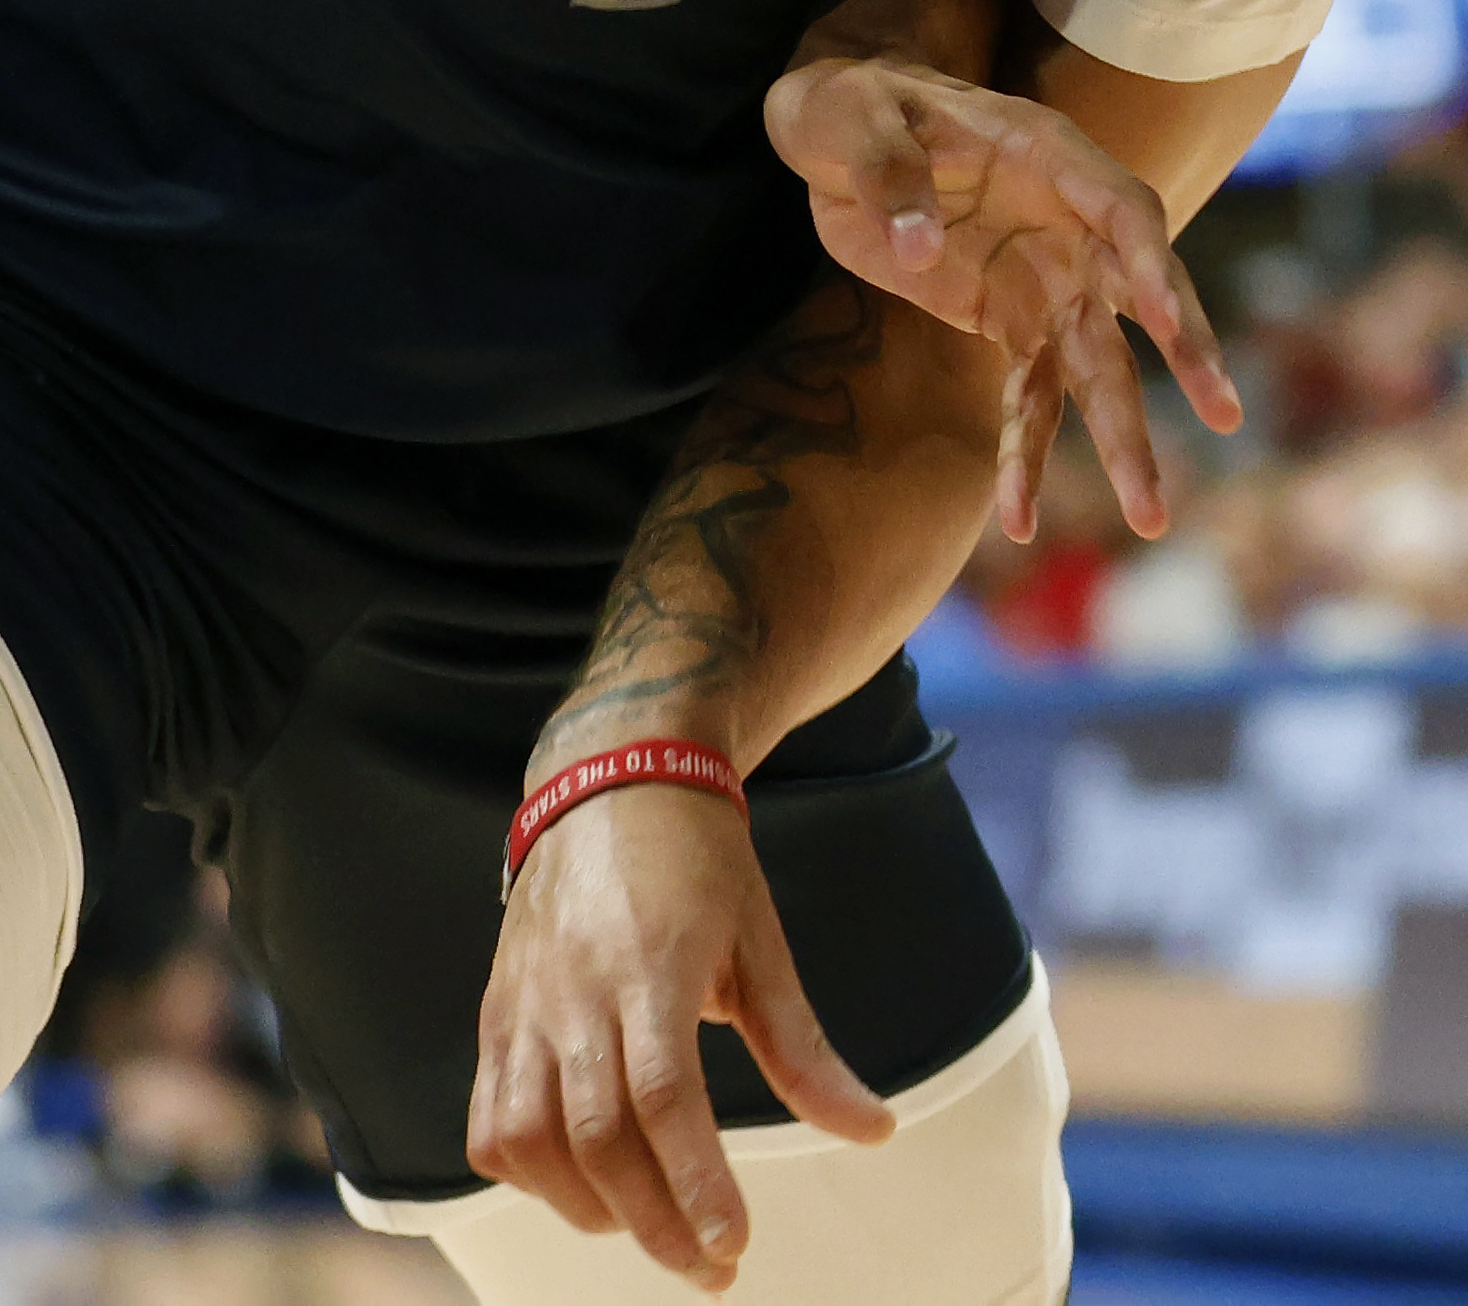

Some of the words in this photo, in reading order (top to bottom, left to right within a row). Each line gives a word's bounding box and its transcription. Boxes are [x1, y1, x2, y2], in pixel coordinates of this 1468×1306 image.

[576, 755, 619, 791] THE
[625, 747, 655, 774] TO
[519, 774, 572, 839] STARS
